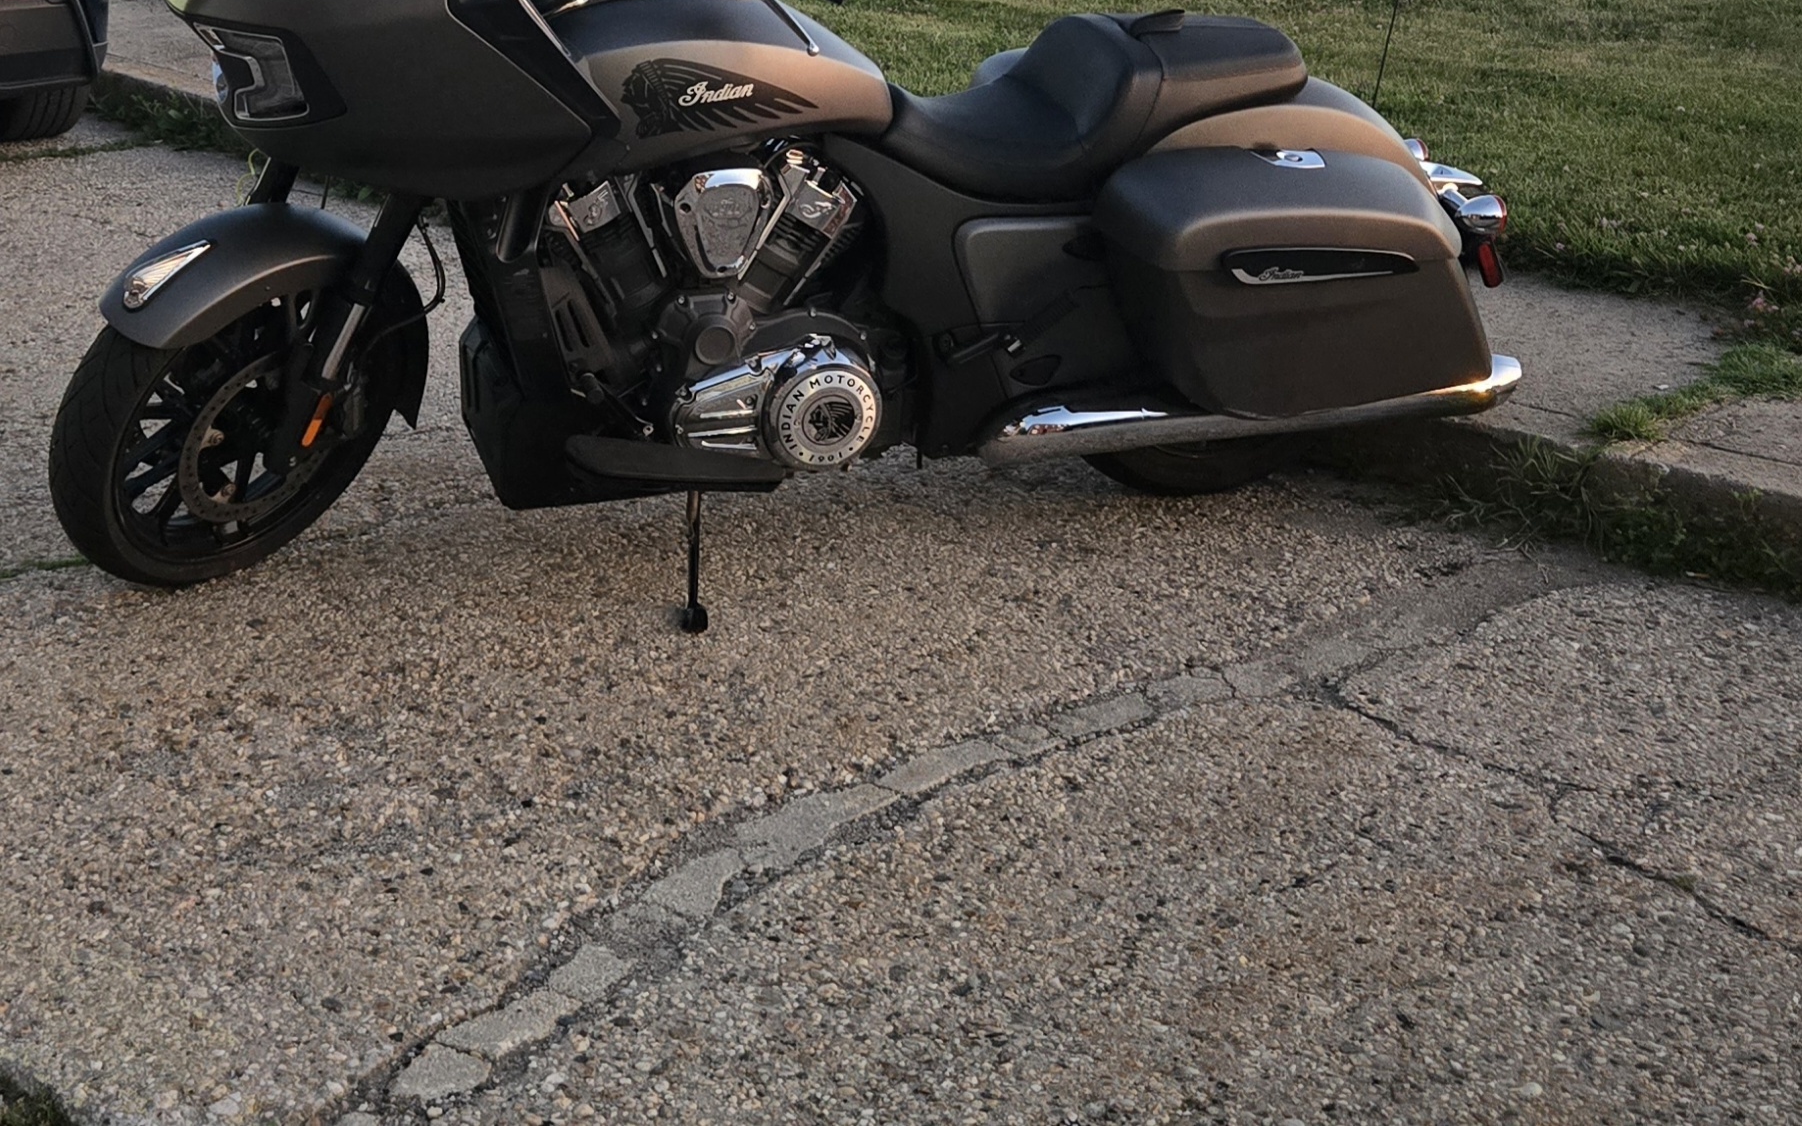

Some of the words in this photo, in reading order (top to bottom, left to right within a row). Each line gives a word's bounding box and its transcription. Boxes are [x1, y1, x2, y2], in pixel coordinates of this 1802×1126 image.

[678, 81, 754, 106] Indian
[1258, 266, 1304, 281] Indian
[781, 389, 805, 450] INDIAN
[809, 374, 874, 443] MOTORCYCLE
[808, 451, 843, 462] 1901
